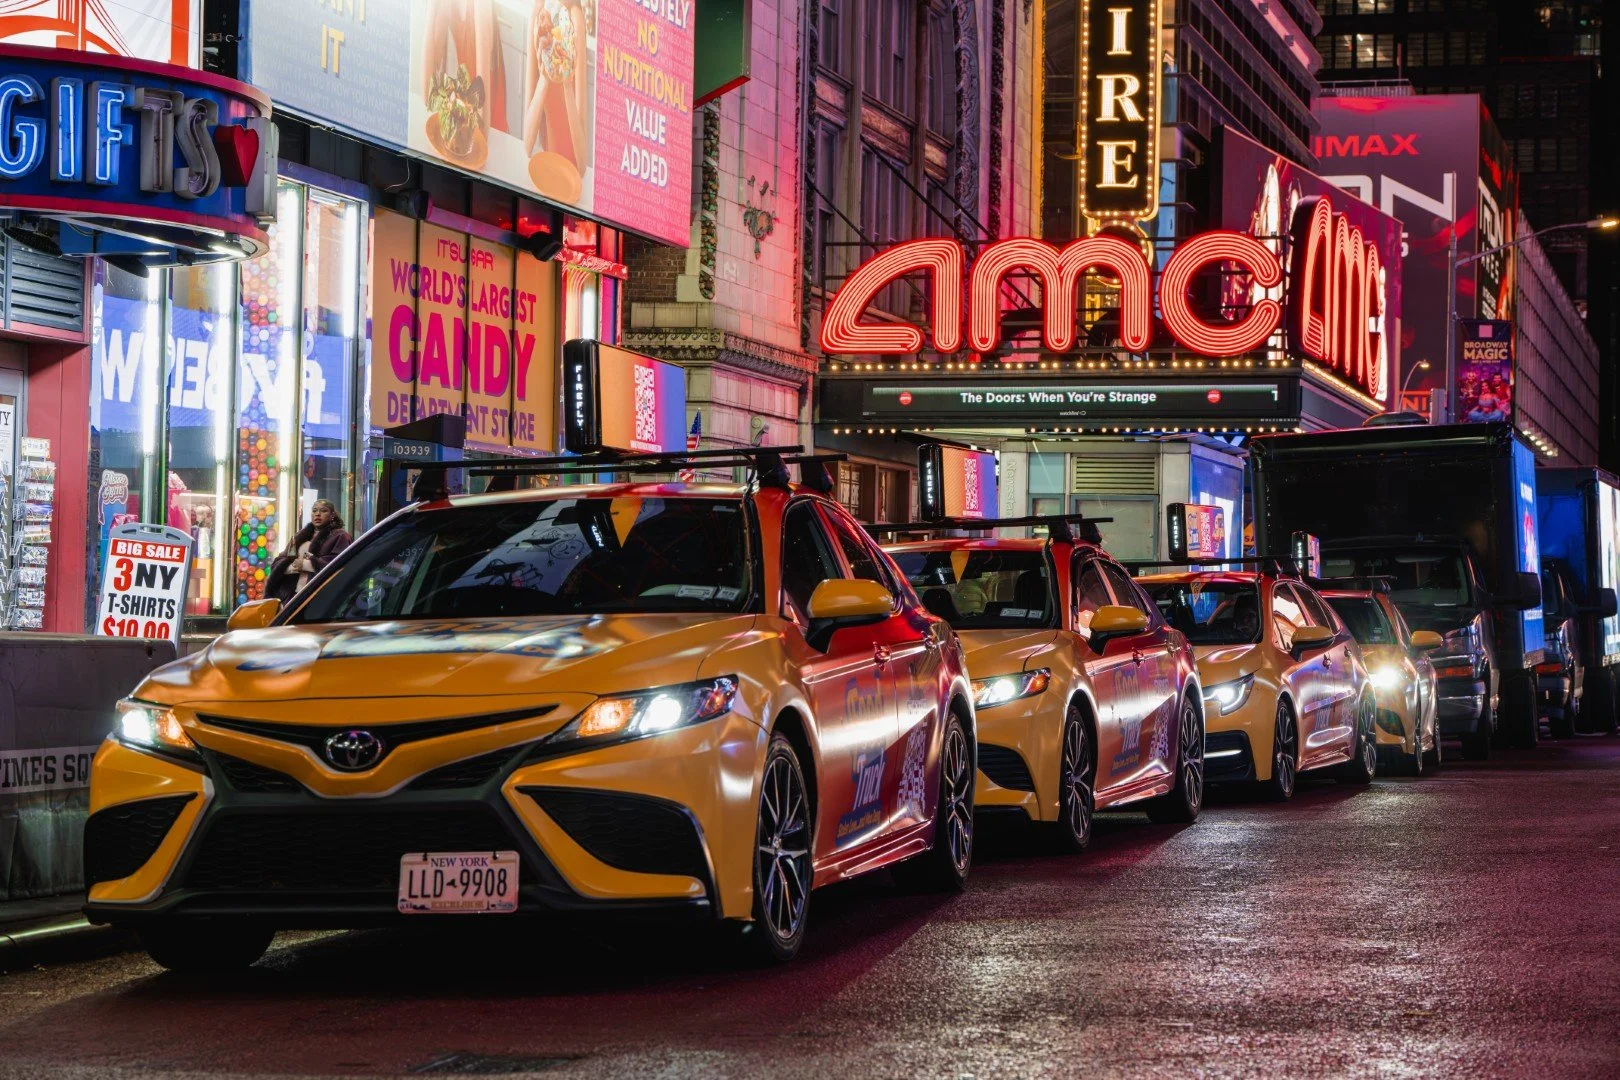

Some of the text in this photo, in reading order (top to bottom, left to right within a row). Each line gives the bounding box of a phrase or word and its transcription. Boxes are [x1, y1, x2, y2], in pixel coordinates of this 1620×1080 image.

[321, 24, 345, 75] IT
[638, 19, 658, 56] NO
[603, 43, 688, 114] NUTRITIONAL
[0, 74, 220, 198] GIFTS
[626, 98, 667, 146] VALUE
[1314, 133, 1420, 158] IMAX
[620, 142, 668, 188] ADDED
[391, 258, 537, 325] WORLD'S LARGEST
[388, 304, 536, 402] CANDY
[1464, 341, 1509, 349] BROADWAY
[1464, 349, 1508, 360] MAGIC
[575, 364, 584, 427] FIREFLY
[960, 391, 1157, 404] The Doors: When You're Strange
[491, 407, 535, 442] STORE
[116, 541, 181, 560] BIG SALE
[108, 592, 176, 620] T-SHIRTS
[0, 753, 97, 788] IMES SQ
[430, 857, 489, 868] NEW YORK
[408, 868, 507, 898] LLD 9908
